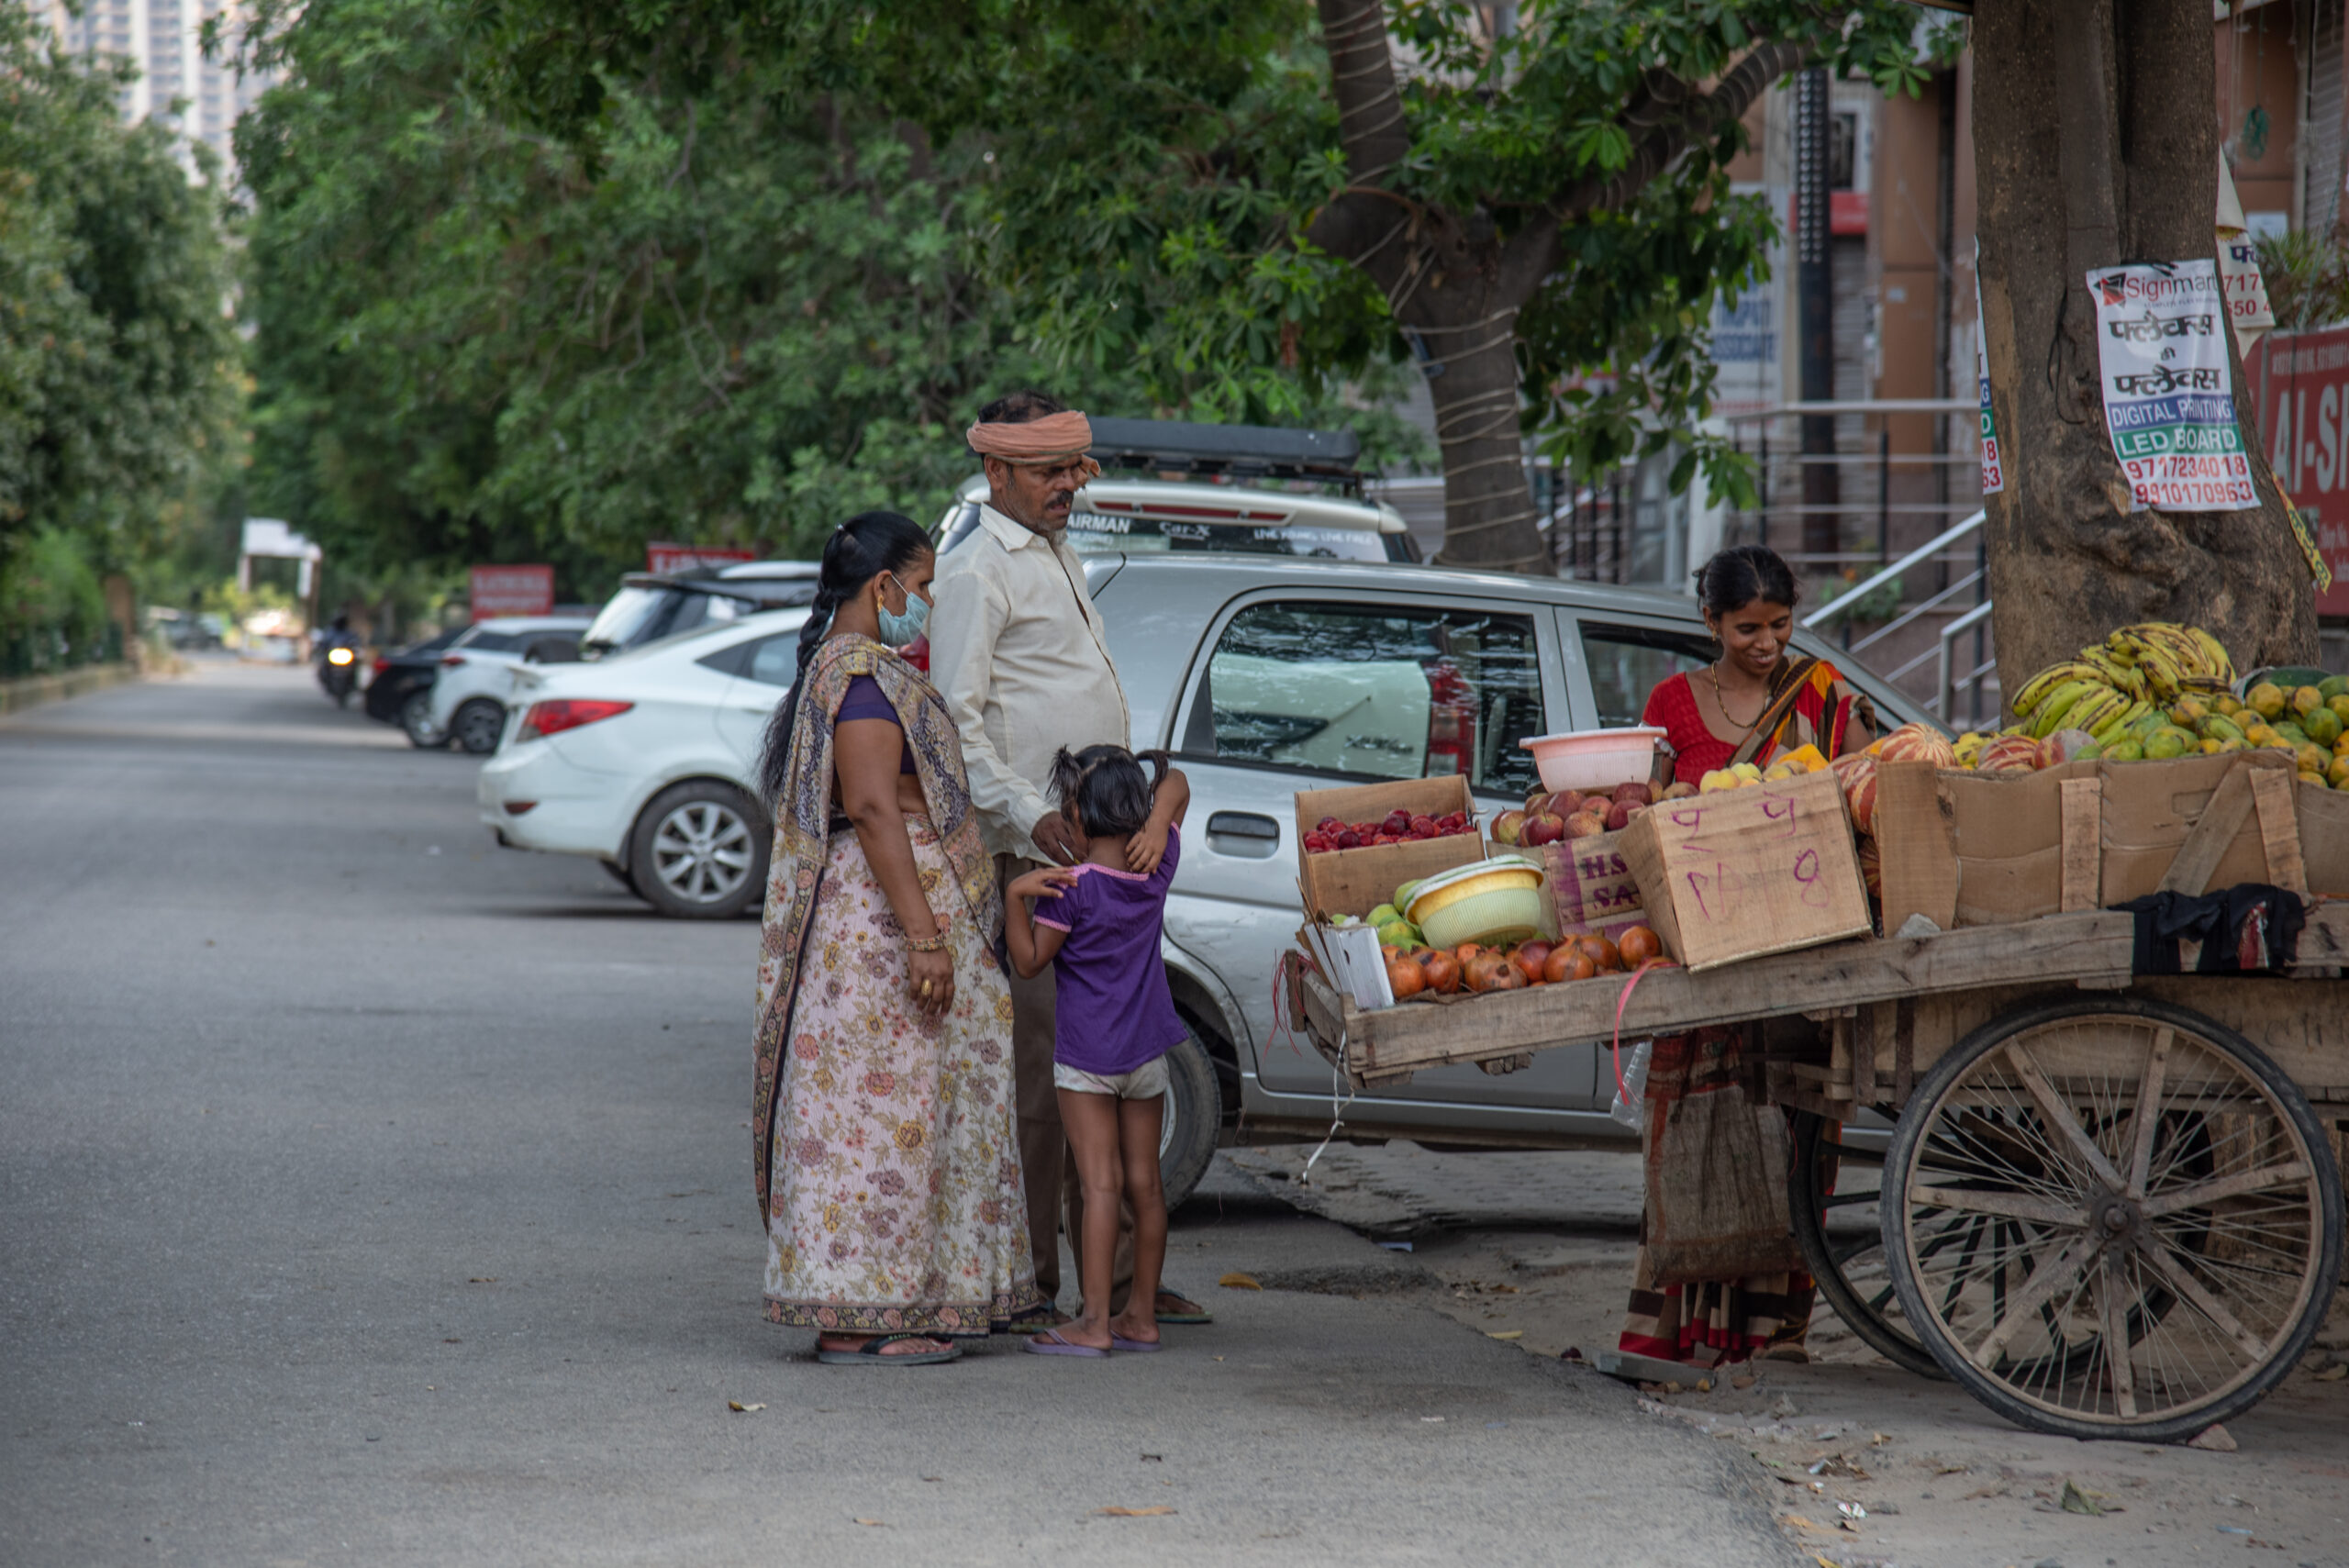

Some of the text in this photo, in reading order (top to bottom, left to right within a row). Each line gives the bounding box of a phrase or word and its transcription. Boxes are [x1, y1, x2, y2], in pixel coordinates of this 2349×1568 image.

[2125, 272, 2218, 302] Signmart
[2111, 398, 2232, 428] DIGITAL PRINTING
[2118, 428, 2237, 456] LED BOARD
[2126, 455, 2247, 480] 9717234018
[2135, 480, 2253, 504] 9910170963
